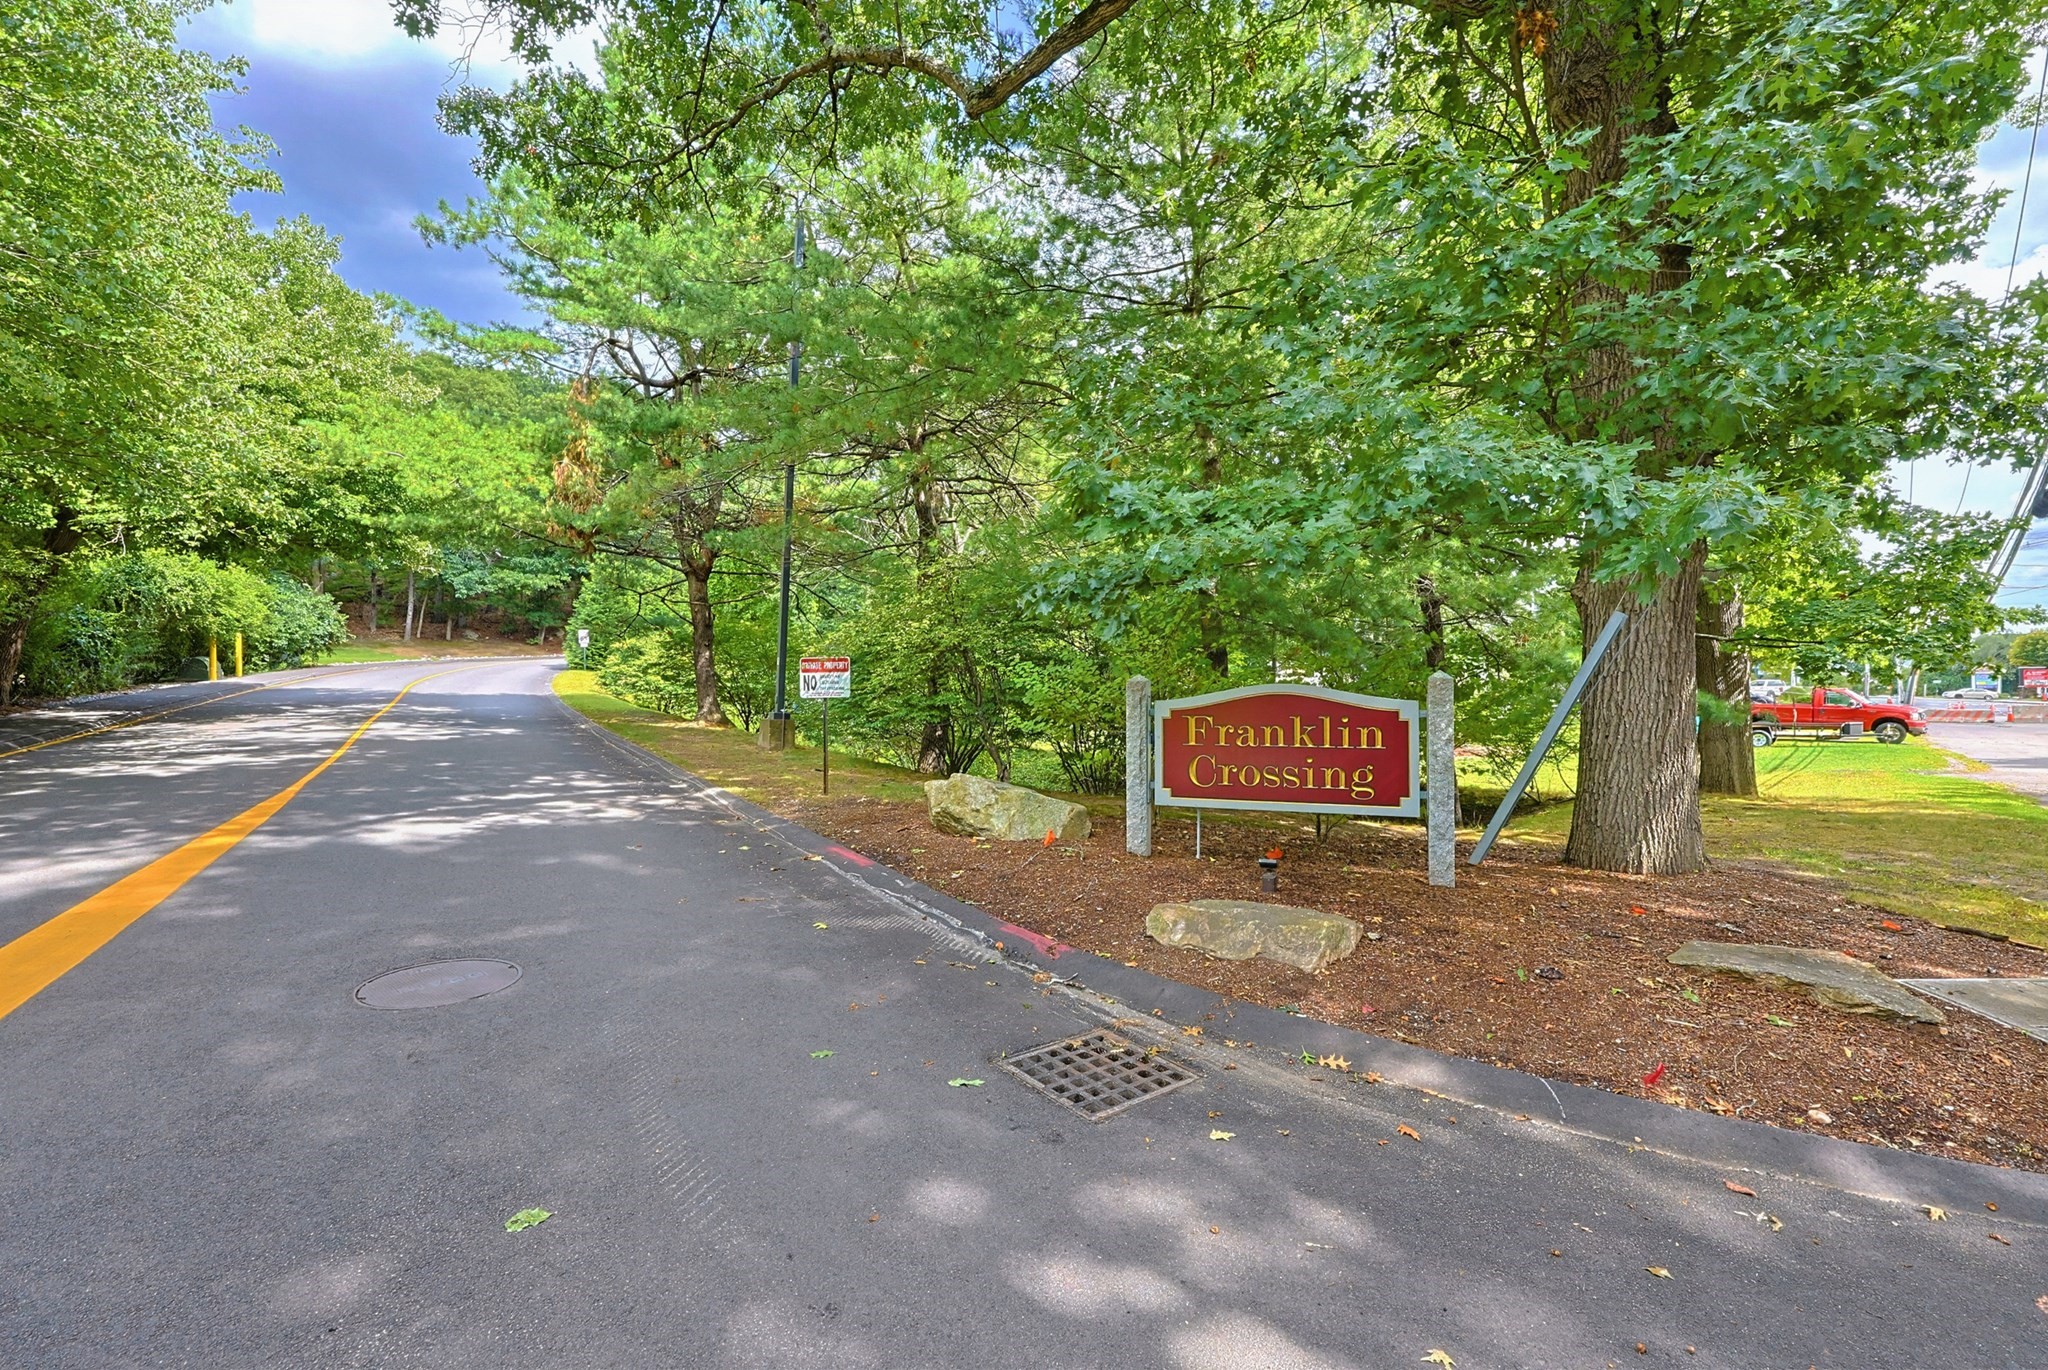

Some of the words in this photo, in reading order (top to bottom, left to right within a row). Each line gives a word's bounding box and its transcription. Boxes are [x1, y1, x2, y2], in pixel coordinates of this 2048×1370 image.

[803, 675, 817, 691] NO
[1181, 714, 1386, 750] Franklin
[1188, 754, 1375, 800] Crossing
